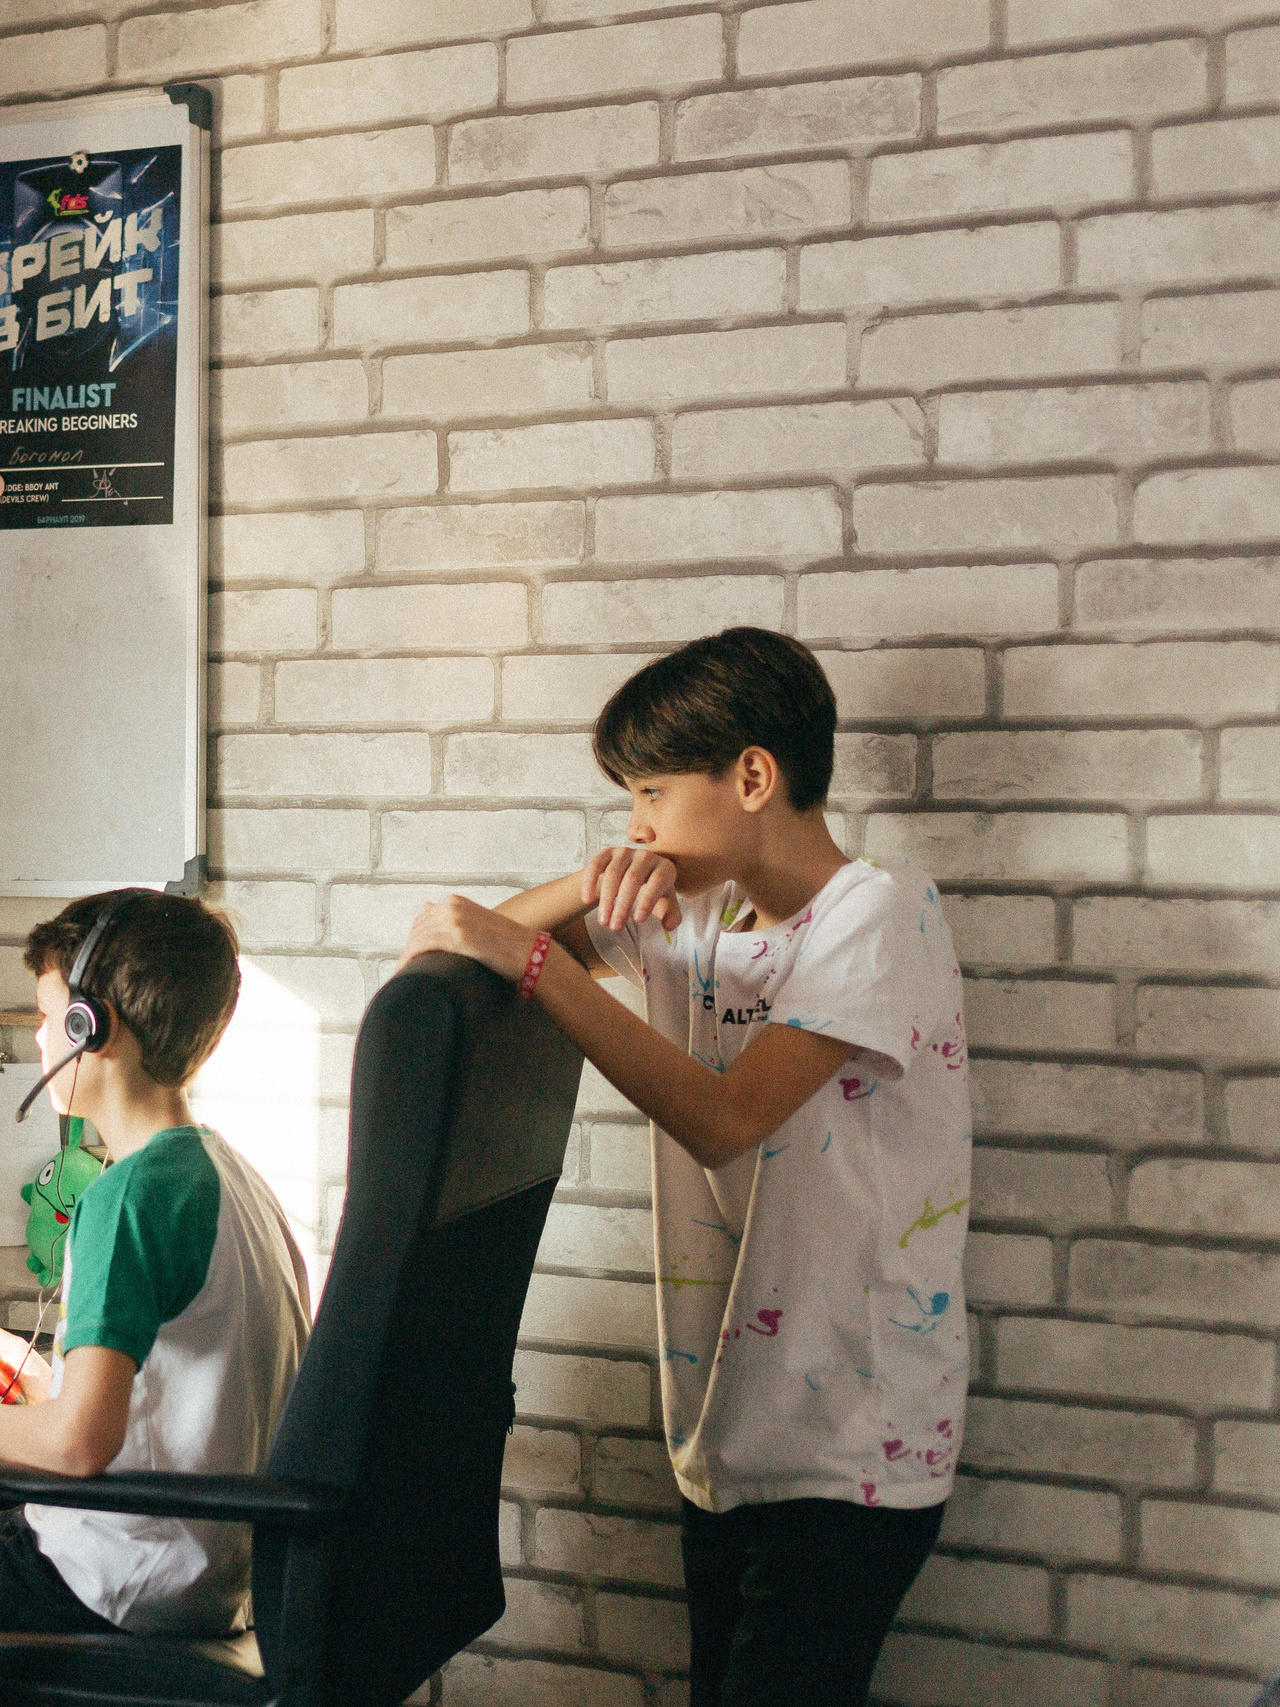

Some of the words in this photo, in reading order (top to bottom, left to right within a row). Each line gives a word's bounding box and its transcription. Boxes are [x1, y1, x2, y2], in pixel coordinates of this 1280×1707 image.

[36, 268, 153, 341] БИТ
[12, 383, 116, 412] FINALIST
[62, 413, 138, 432] BEGGINERS
[25, 483, 44, 491] BBOY
[44, 482, 59, 490] ANT
[0, 495, 24, 504] (DEVILS
[26, 494, 50, 503] CREW)
